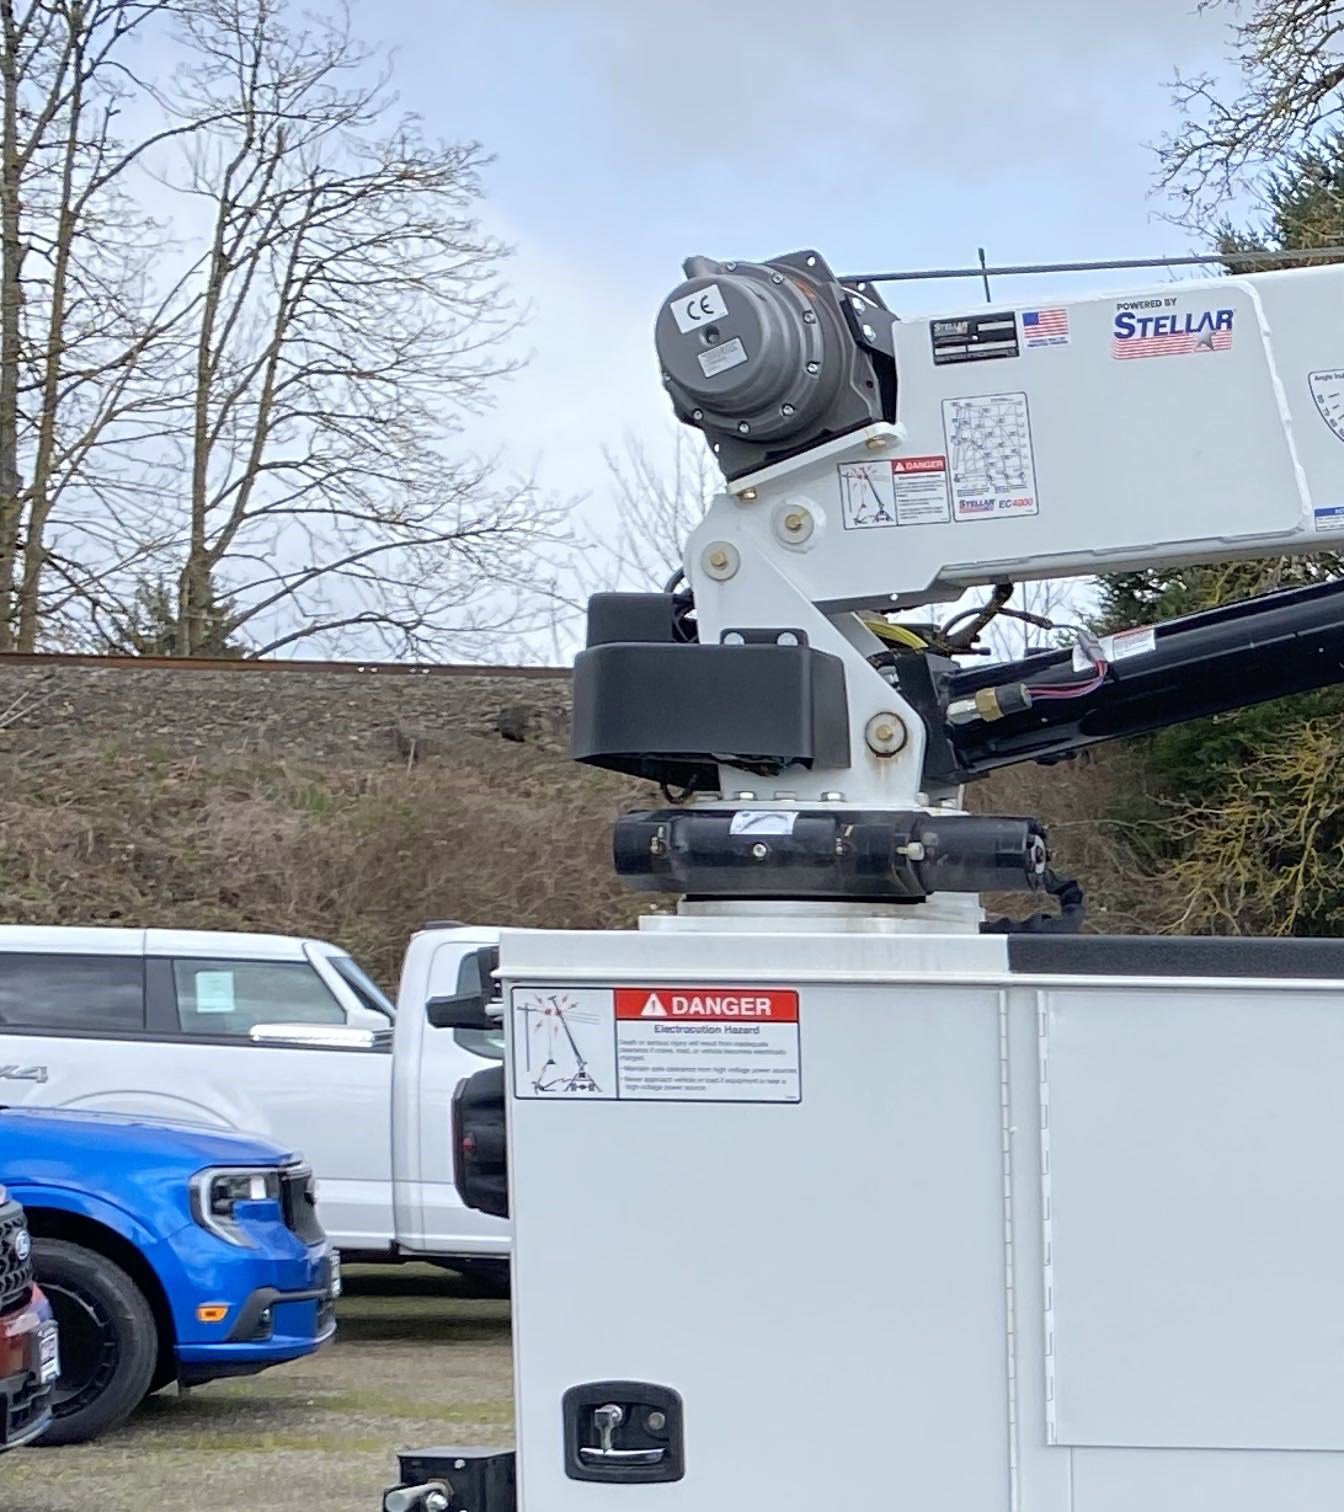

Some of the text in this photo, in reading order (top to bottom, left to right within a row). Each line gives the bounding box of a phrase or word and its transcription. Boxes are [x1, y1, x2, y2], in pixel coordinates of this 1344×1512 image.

[1116, 297, 1177, 311] POWERED BY
[1113, 309, 1234, 340] STELLAR
[671, 996, 772, 1016] DANGER
[654, 1024, 760, 1035] Electrocution Hazard
